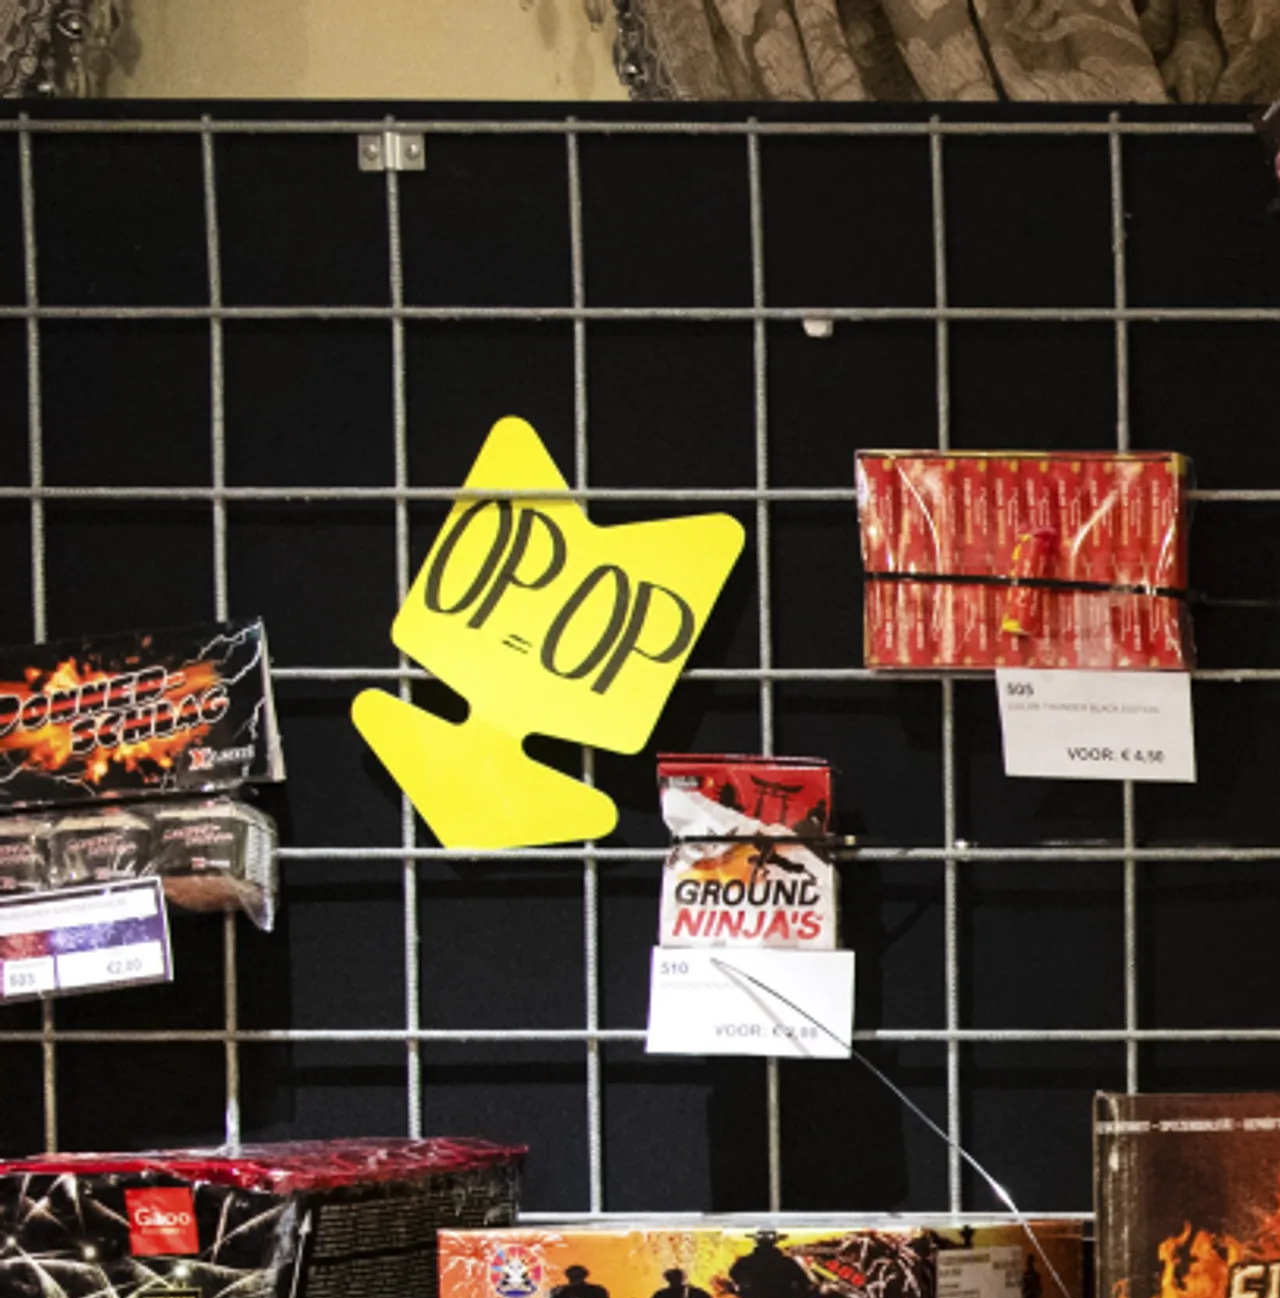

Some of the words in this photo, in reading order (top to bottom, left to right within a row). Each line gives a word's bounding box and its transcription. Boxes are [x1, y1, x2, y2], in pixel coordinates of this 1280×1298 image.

[423, 499, 567, 630] OP
[540, 564, 695, 695] OP
[675, 879, 820, 906] GROUND
[672, 909, 823, 940] NINJA'S
